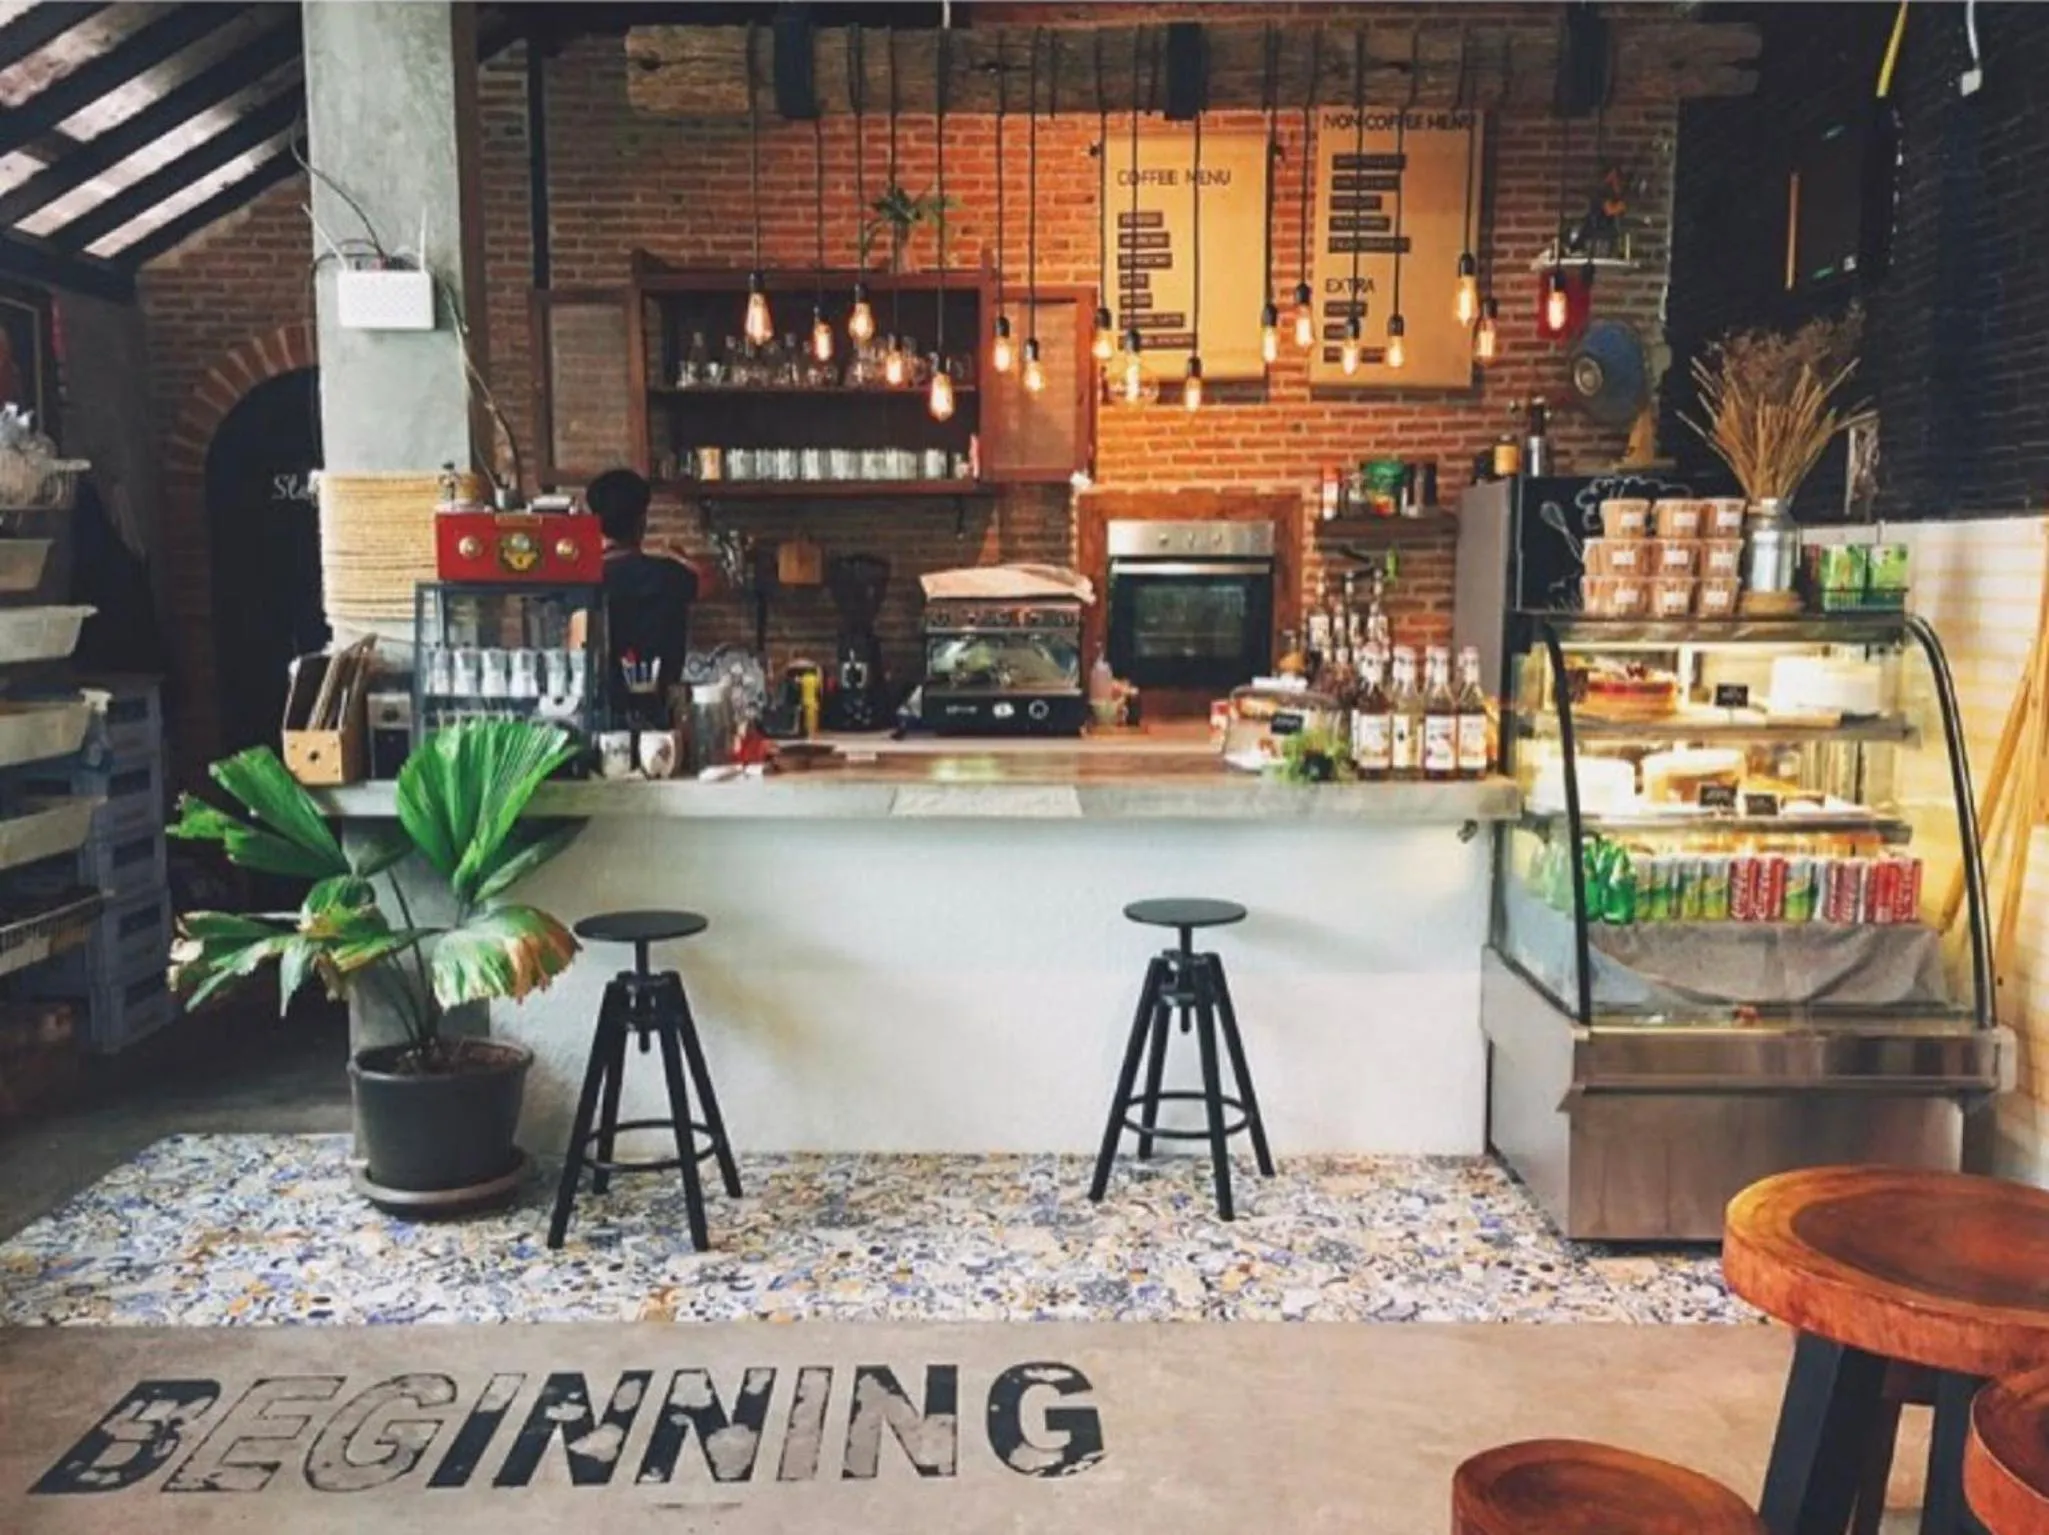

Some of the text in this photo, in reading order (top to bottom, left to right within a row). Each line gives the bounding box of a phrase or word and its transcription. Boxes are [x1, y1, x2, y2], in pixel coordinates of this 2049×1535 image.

[1366, 112, 1425, 131] COFFEE
[1117, 168, 1231, 187] COFFEE MENU
[1325, 277, 1375, 295] EXTRA
[28, 1361, 1107, 1494] BEGINNING
